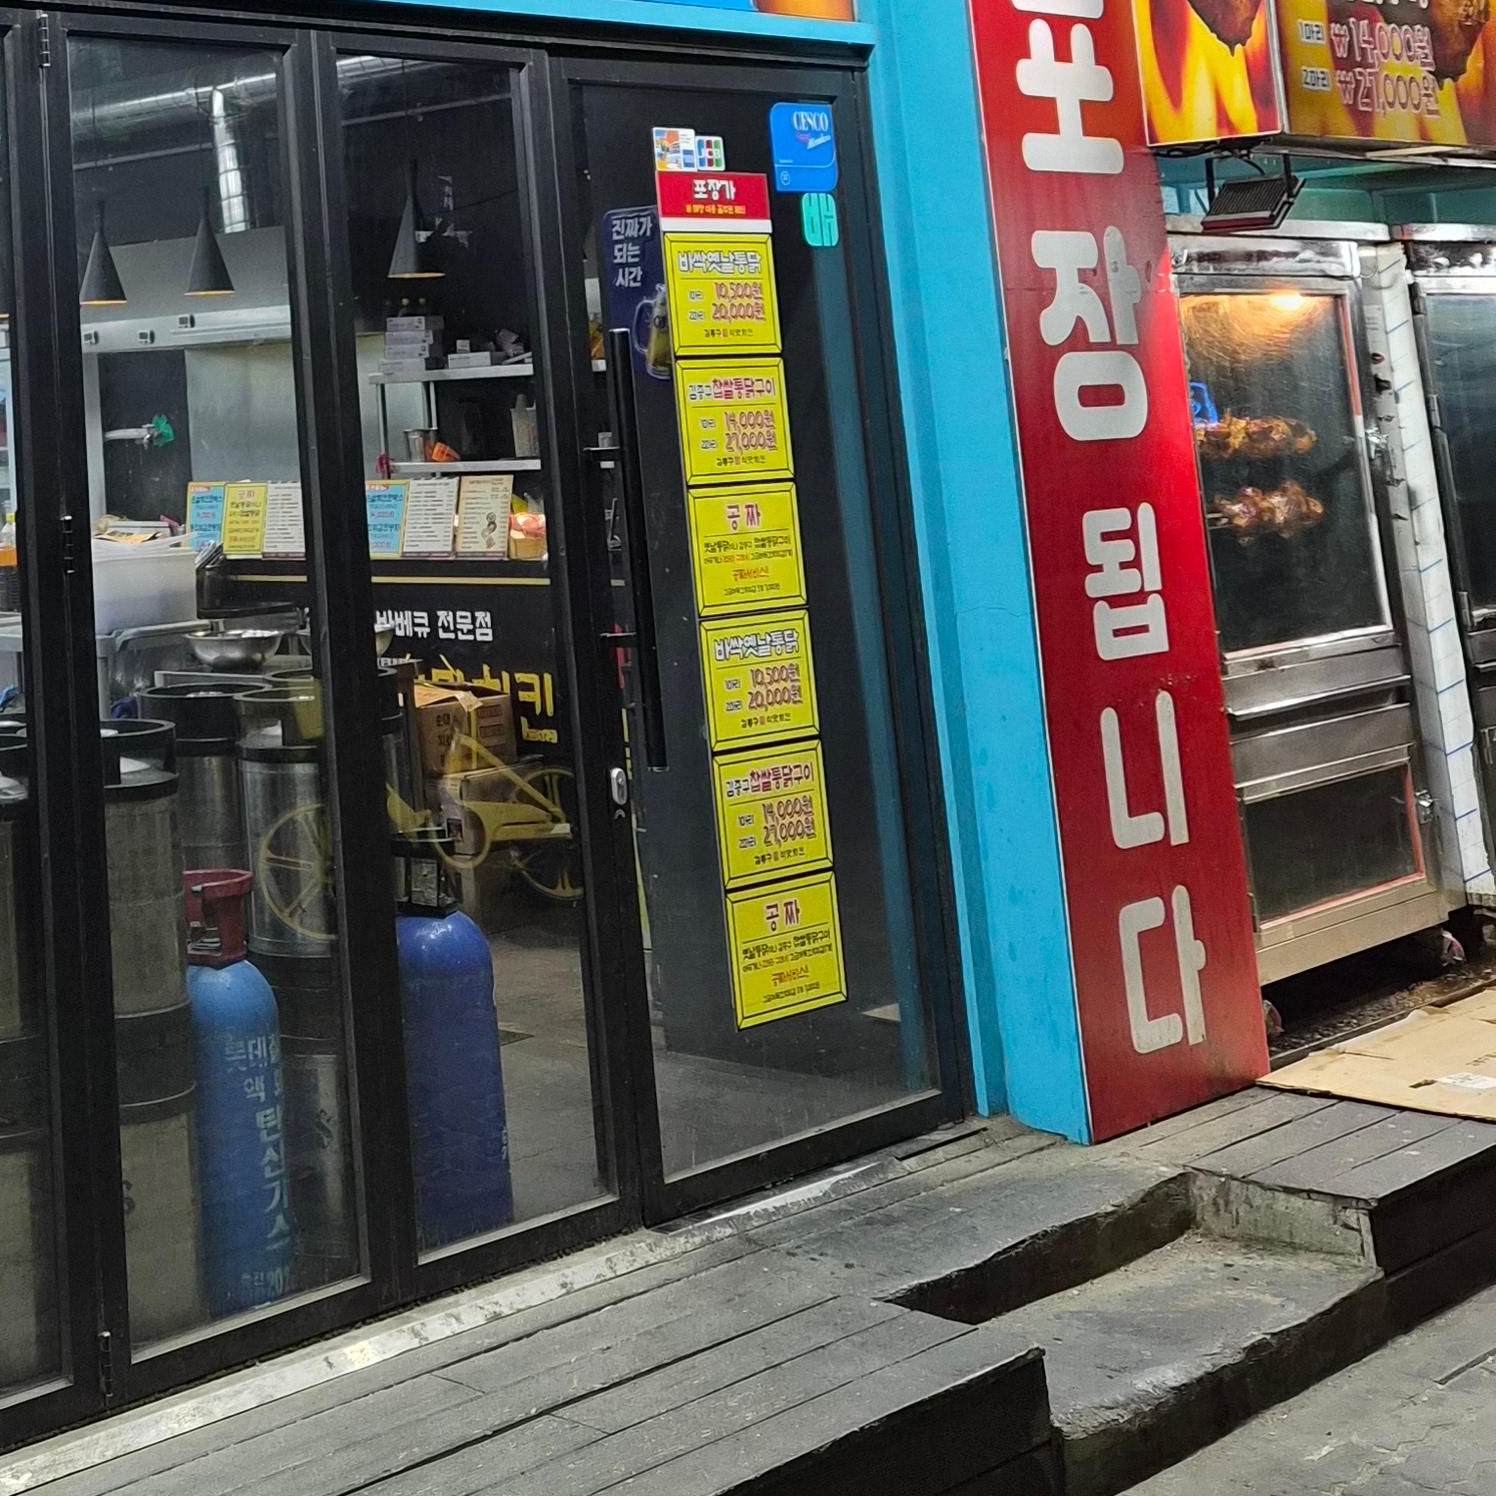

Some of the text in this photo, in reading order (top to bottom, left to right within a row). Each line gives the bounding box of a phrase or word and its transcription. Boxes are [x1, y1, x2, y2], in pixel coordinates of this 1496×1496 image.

[793, 111, 829, 132] CESCO
[692, 178, 736, 201] 포장가
[611, 215, 653, 241] 진짜가
[613, 242, 641, 264] 되는
[615, 266, 643, 288] 시간
[436, 610, 494, 642] 전문점
